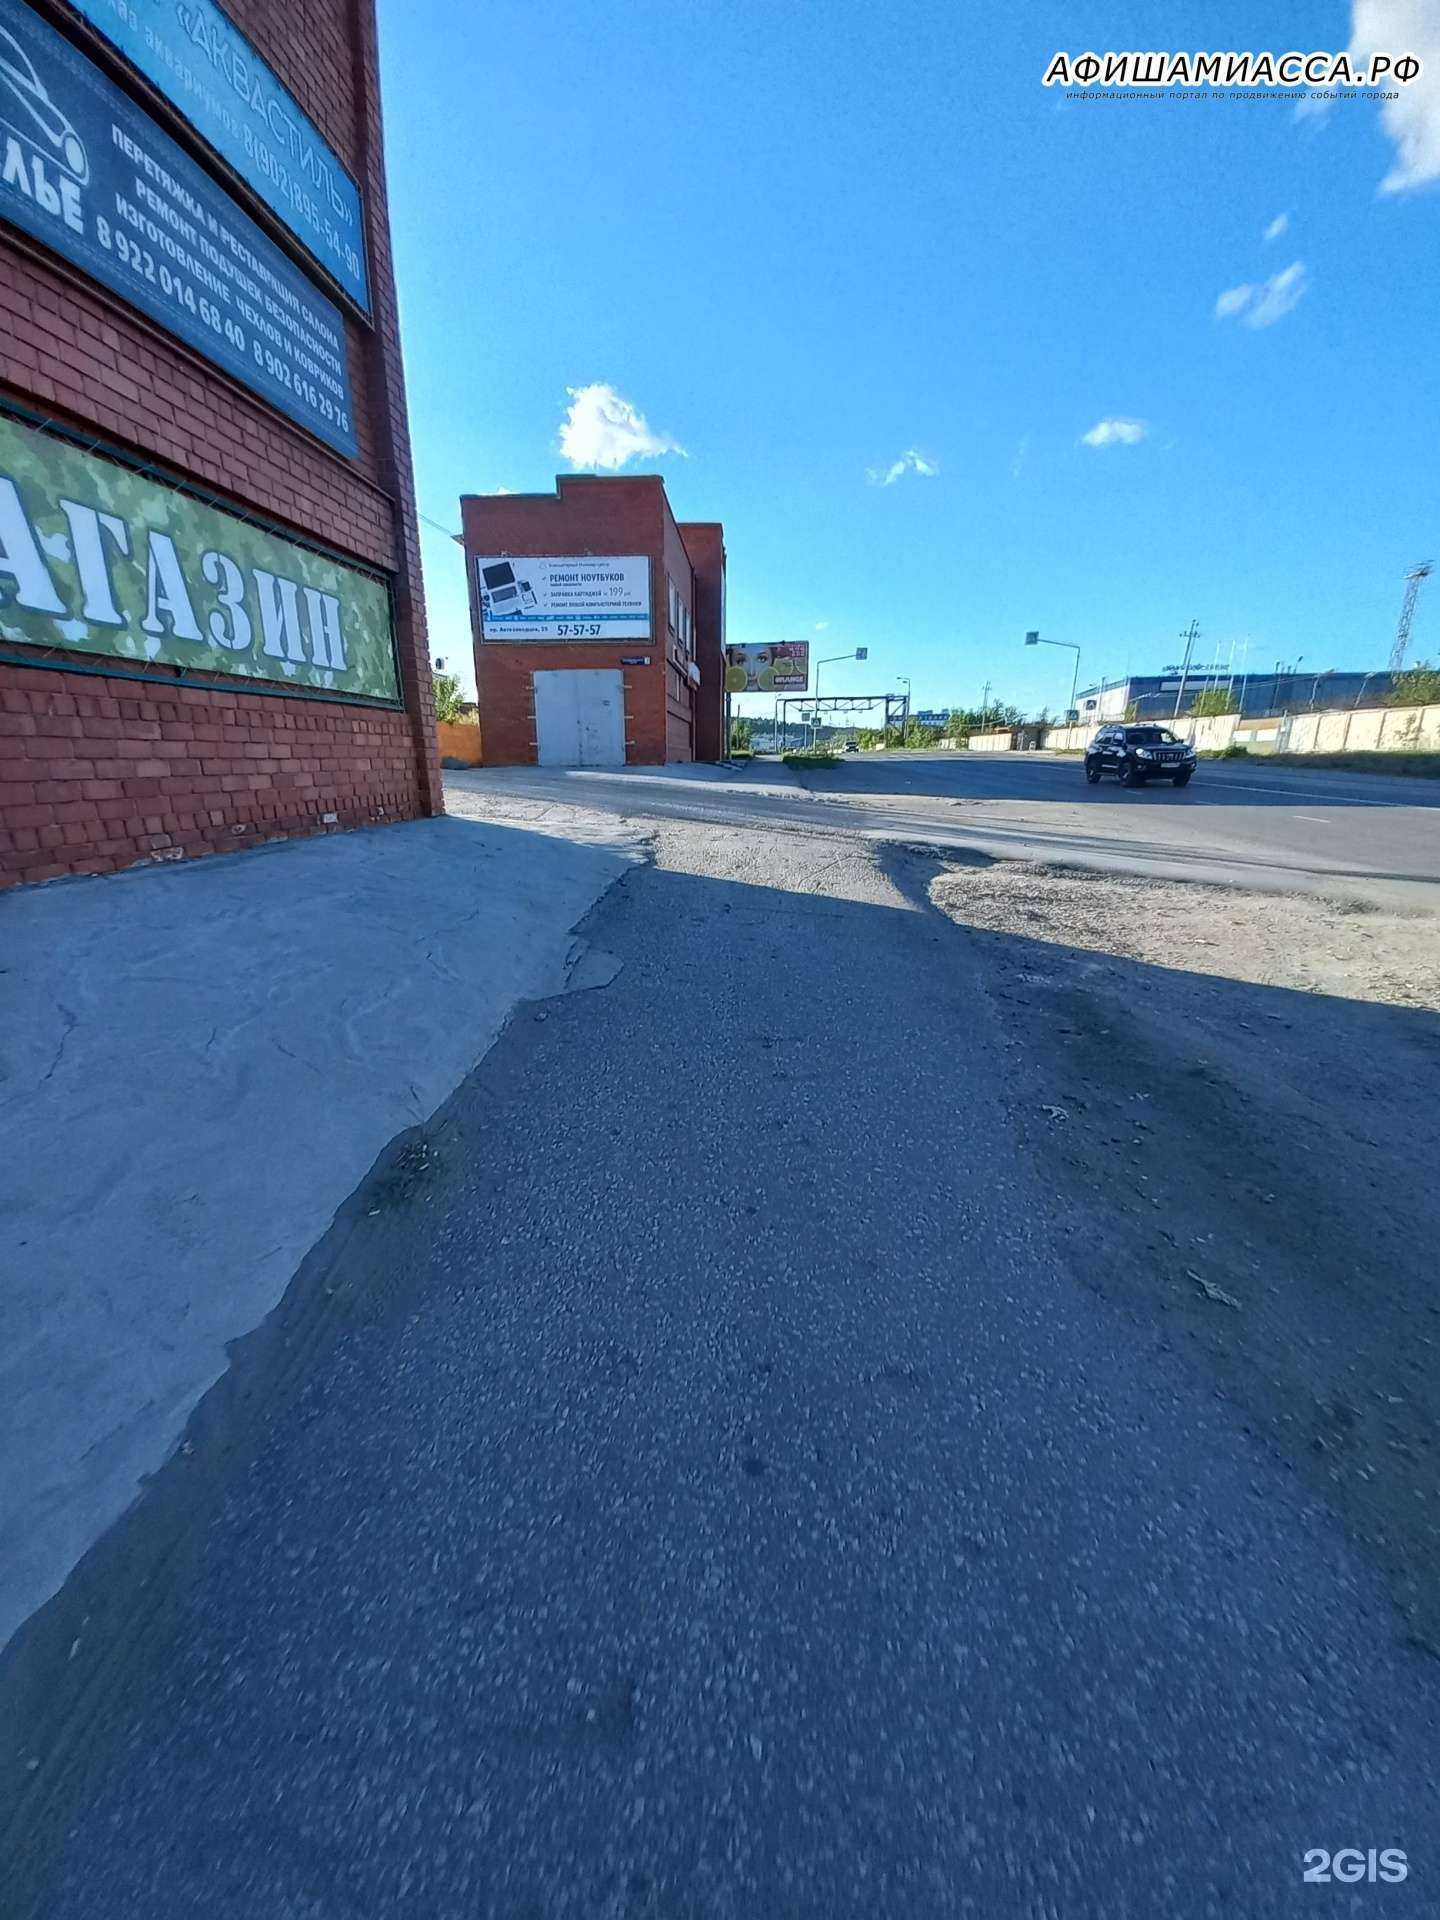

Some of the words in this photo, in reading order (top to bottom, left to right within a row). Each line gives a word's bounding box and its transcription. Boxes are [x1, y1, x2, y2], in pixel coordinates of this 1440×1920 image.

[97, 215, 112, 250] 8
[115, 230, 157, 284] 922
[159, 264, 198, 315] 014
[199, 297, 222, 335] 68
[224, 318, 246, 352] 40
[253, 340, 264, 366] 8
[265, 350, 292, 390] 902
[293, 375, 318, 409] 616
[319, 393, 334, 421] 29
[334, 406, 350, 433] 76
[111, 123, 206, 226] ПЕРЕТЯЖКА
[207, 212, 219, 238] И
[220, 226, 300, 314] РЕСТАВРАЦИЯ
[301, 305, 340, 352] САЛОНА
[115, 192, 231, 304] ИЗГОТОВЛЕНИЕ
[236, 295, 282, 348] ЧЕХЛОВ
[284, 338, 293, 357] И
[293, 345, 344, 400] КОВРИКОВ
[135, 176, 198, 247] РЕМОНТ
[200, 236, 264, 305] ПОДУШЕК
[265, 294, 342, 377] БЕЗОПАСНОСТИ
[550, 574, 579, 582] РЕМОНТ
[581, 573, 624, 582] НОУТБУКОВ
[557, 624, 601, 636] 57-57-57
